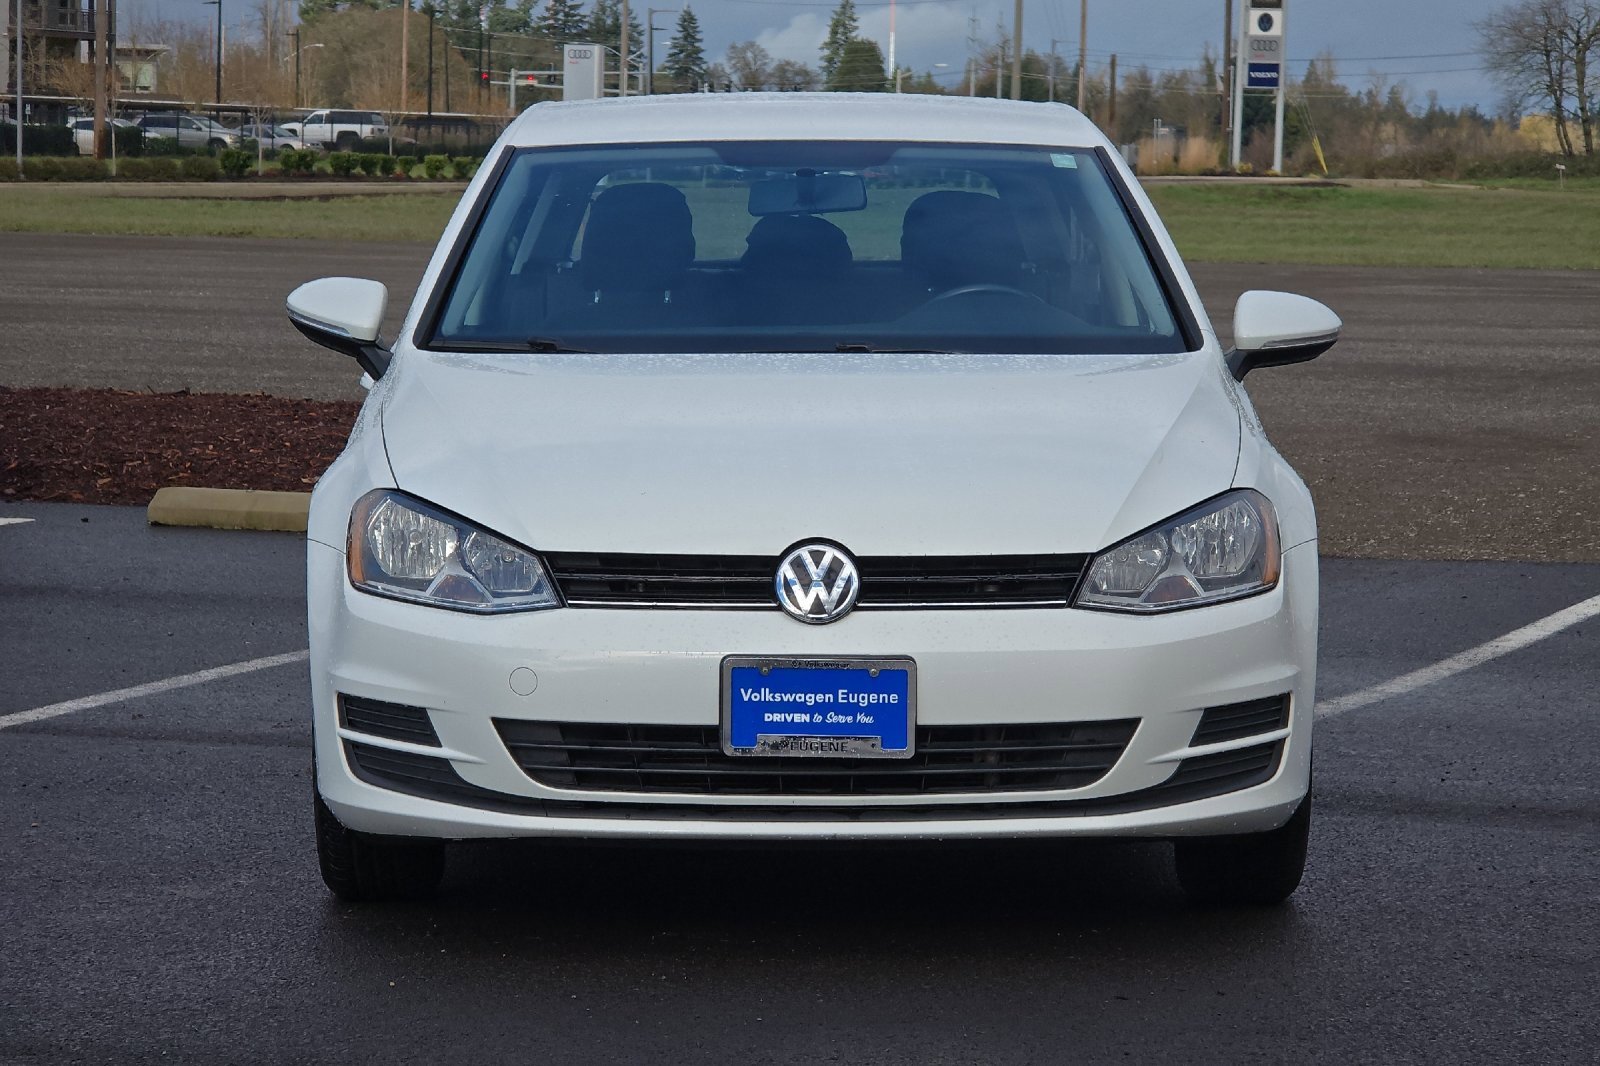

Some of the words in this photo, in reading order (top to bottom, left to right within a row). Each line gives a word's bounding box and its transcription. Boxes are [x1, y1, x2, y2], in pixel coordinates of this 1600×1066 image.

[775, 543, 859, 622] VW
[740, 687, 834, 705] Volkswagen
[838, 689, 899, 706] Eugene
[764, 712, 810, 722] DRIVEN
[812, 712, 823, 723] to
[825, 712, 853, 724] Serve
[856, 712, 874, 724] You
[790, 740, 849, 752] EUGENE
